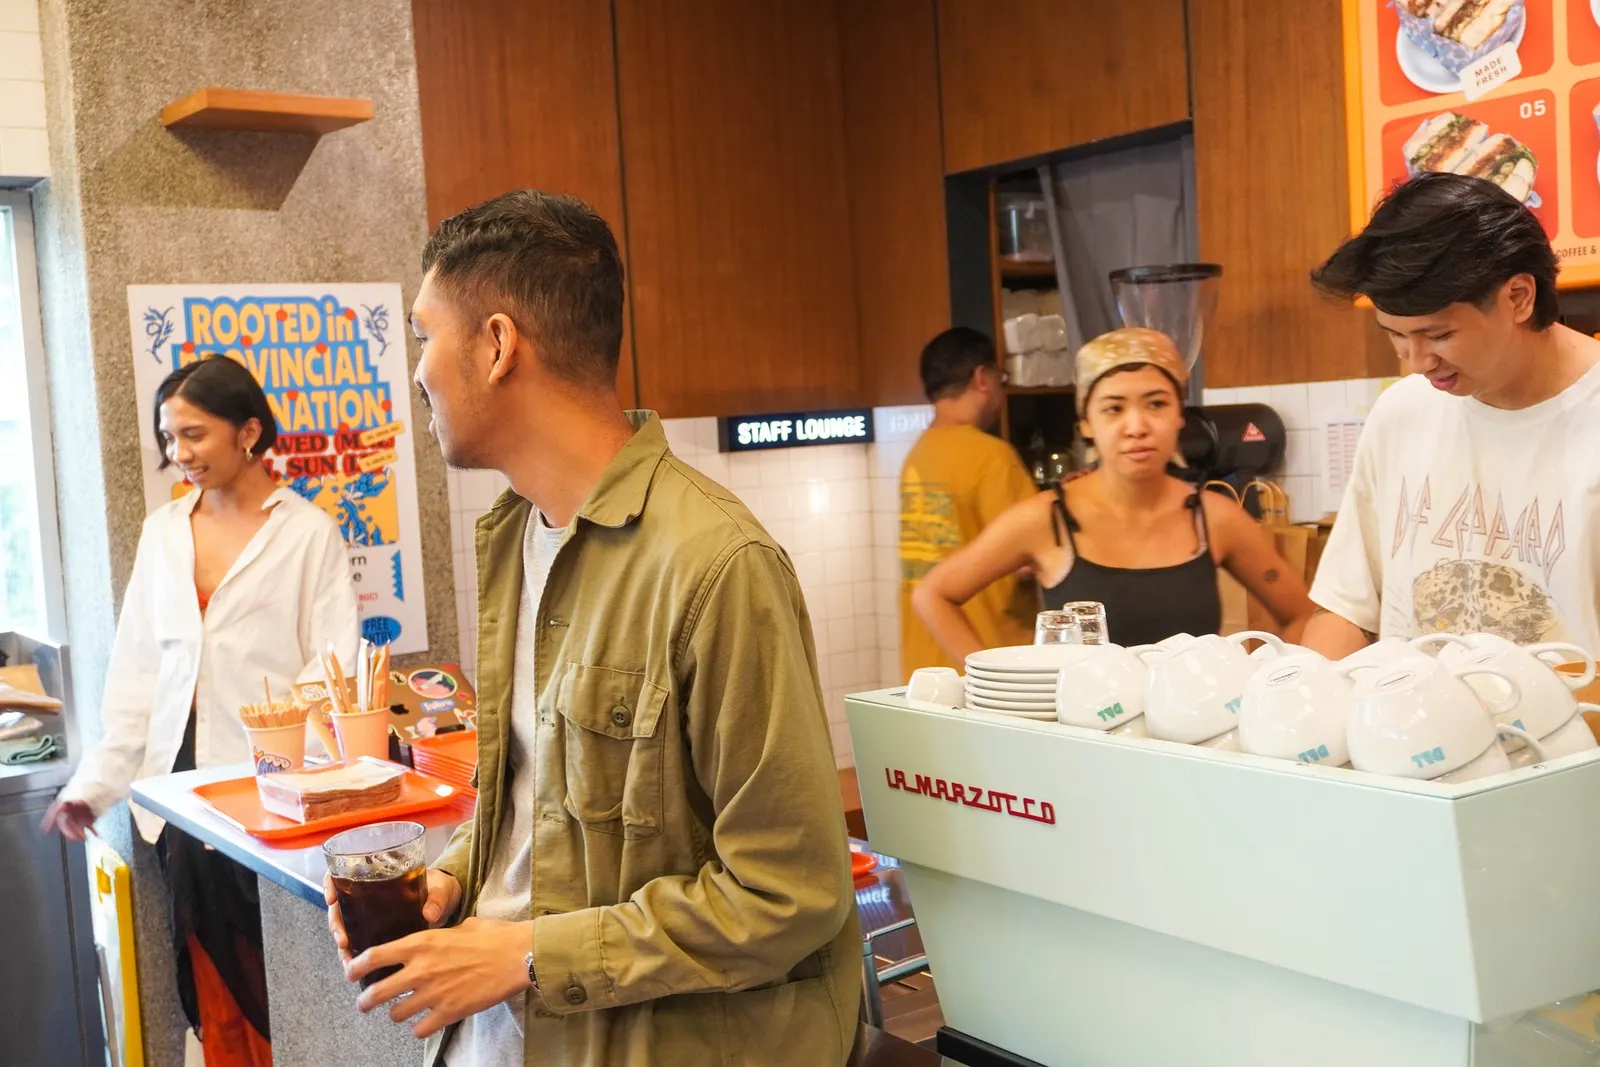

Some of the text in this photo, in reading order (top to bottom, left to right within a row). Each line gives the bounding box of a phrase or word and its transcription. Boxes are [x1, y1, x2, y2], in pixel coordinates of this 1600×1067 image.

[1475, 56, 1502, 77] MADE
[1476, 65, 1507, 87] FRESH
[1519, 99, 1547, 119] 05
[1556, 244, 1597, 258] COFFEE &
[190, 301, 354, 346] ROOTED in
[179, 346, 372, 389] VINCIAL
[737, 416, 867, 445] STAFF LOUNGE
[274, 435, 326, 452] WED
[287, 456, 337, 476] SUN
[885, 767, 906, 790] LA
